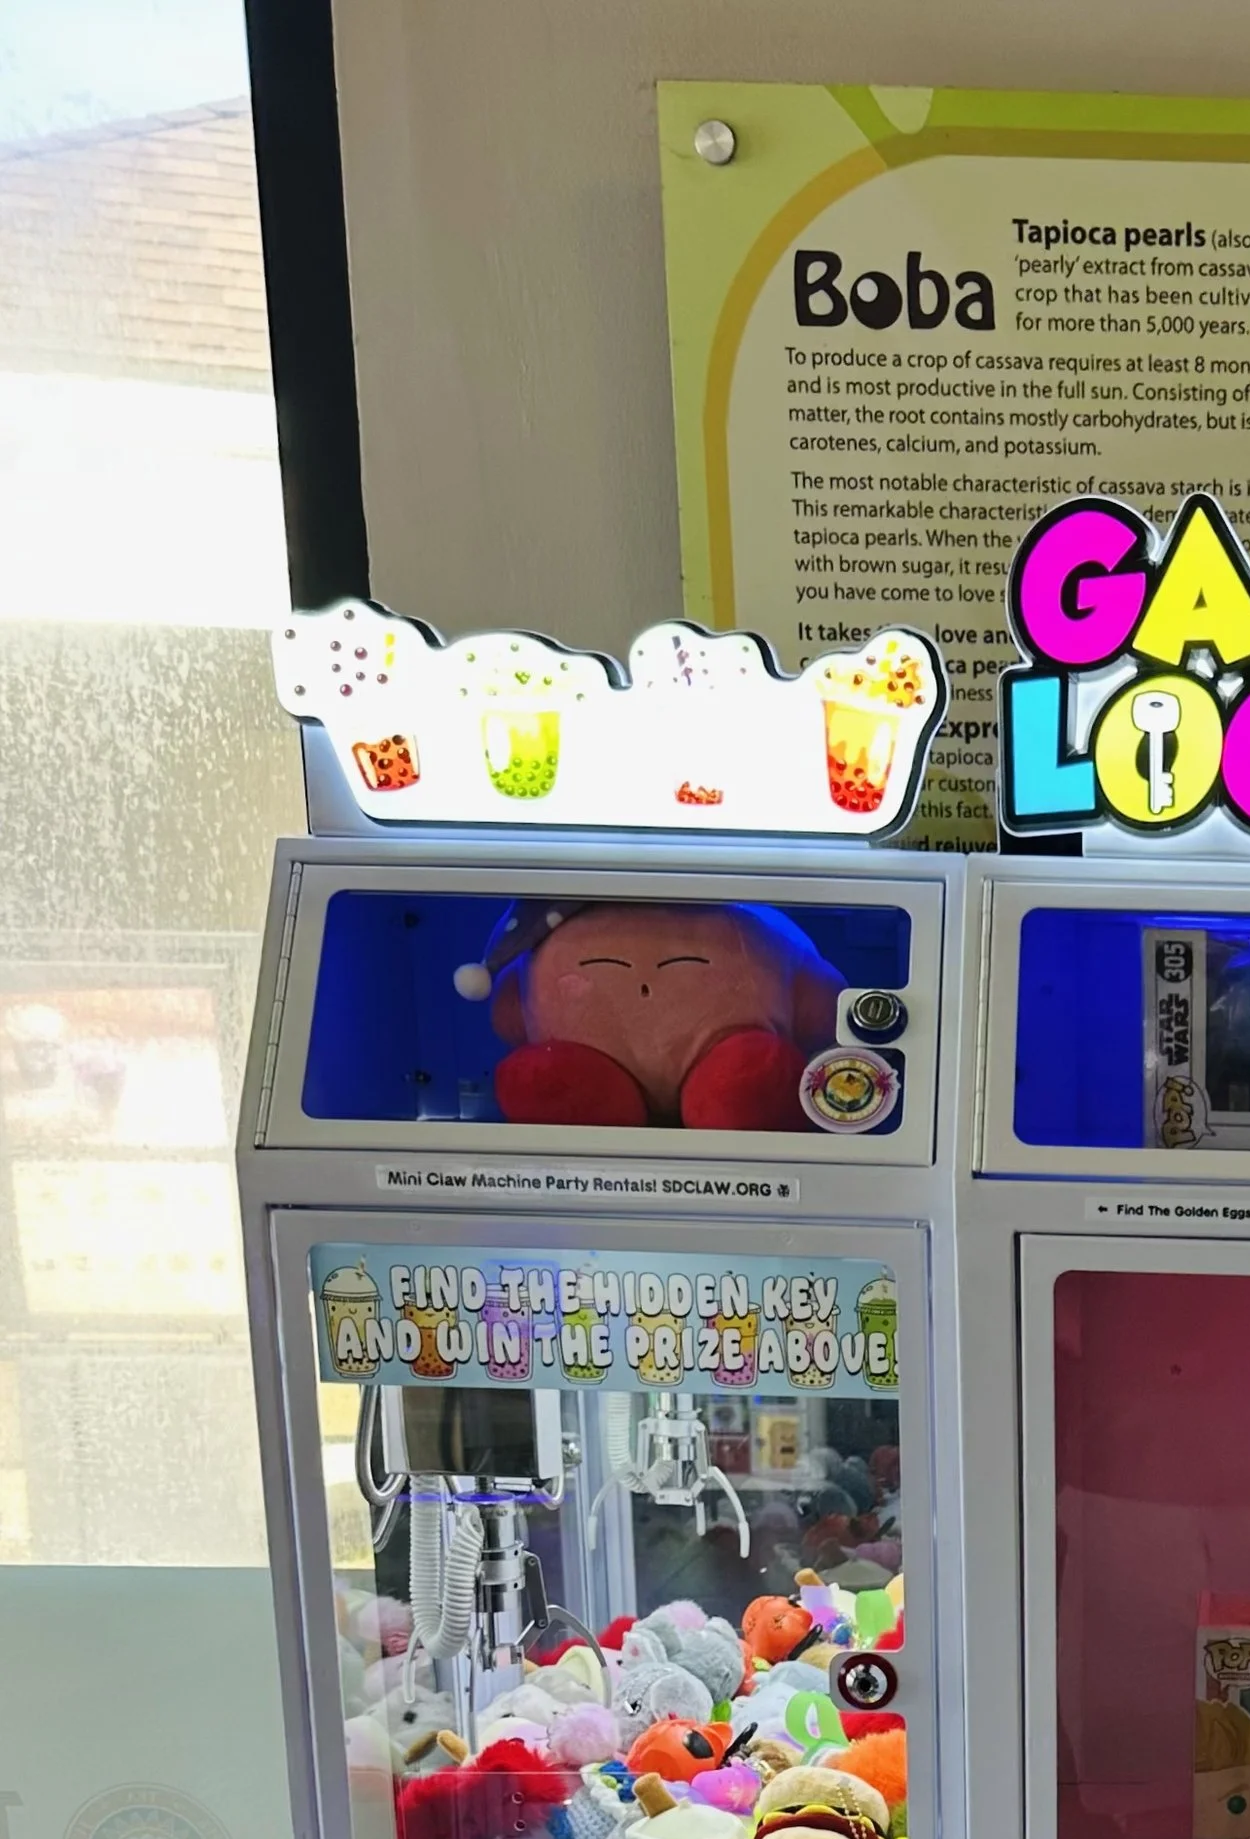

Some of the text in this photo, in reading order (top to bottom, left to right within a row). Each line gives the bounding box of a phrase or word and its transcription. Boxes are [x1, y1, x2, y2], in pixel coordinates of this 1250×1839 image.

[1012, 220, 1116, 250] Tapioca
[1125, 222, 1205, 252] pearls
[1083, 259, 1145, 275] extract
[1151, 257, 1193, 276] from
[794, 250, 996, 330] Boba
[1016, 288, 1057, 305] crop
[1064, 284, 1101, 302] that
[1108, 286, 1139, 303] has
[1146, 286, 1192, 304] been
[1016, 313, 1249, 338] for more than 5,000 years.
[791, 472, 823, 489] The
[830, 476, 873, 489] most
[880, 474, 947, 491] notable
[953, 475, 1071, 493] characteristic
[1076, 476, 1094, 494] of
[1098, 481, 1165, 495] cassava
[1171, 478, 1223, 495] starch
[1230, 480, 1241, 496] is
[1164, 942, 1186, 980] 305
[1173, 997, 1190, 1066] WARS
[1160, 1076, 1197, 1148] POP!
[387, 1171, 772, 1197] Mini Claw Machine Party Rentals! SDCLAW.ORG
[1116, 1204, 1144, 1216] Find
[1147, 1205, 1171, 1217] The
[1174, 1205, 1219, 1218] Golden
[390, 1266, 838, 1322] FIND THE HIDDEN KEY
[336, 1317, 899, 1376] AND WIN THE PRIZE ABOVE!
